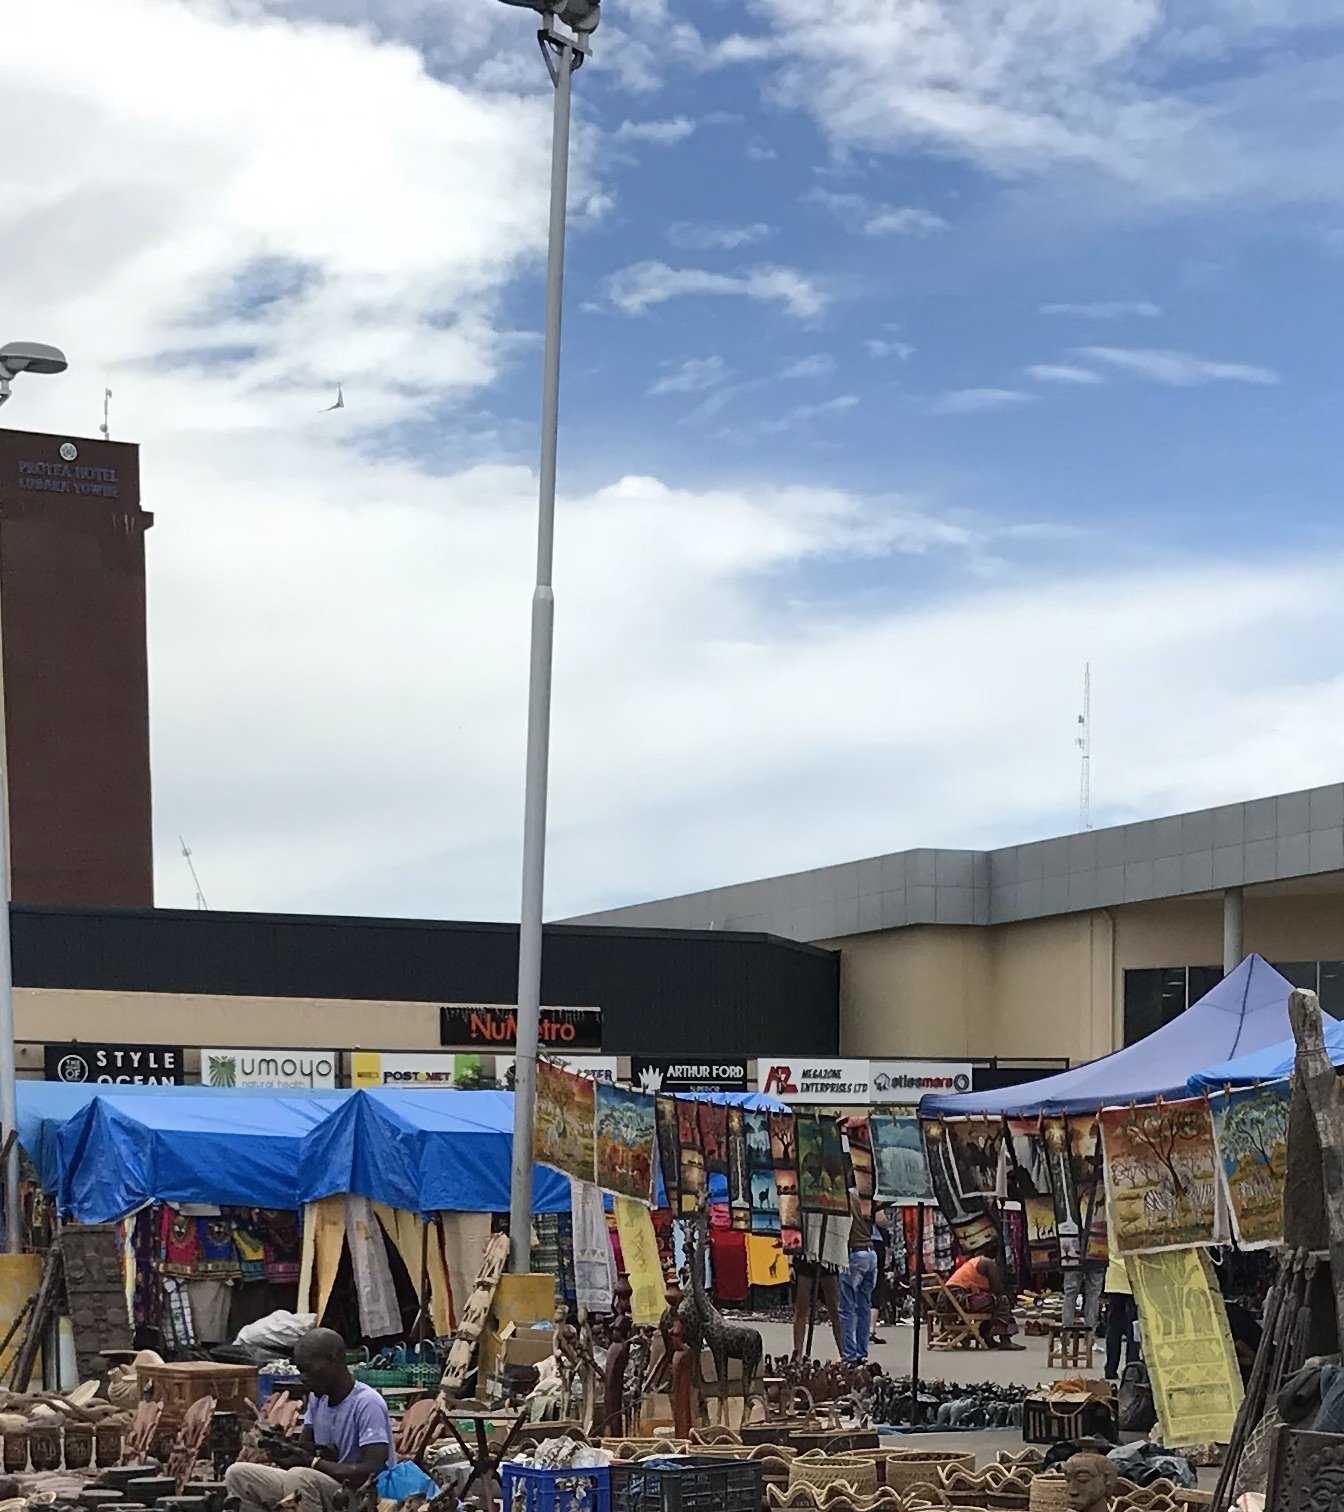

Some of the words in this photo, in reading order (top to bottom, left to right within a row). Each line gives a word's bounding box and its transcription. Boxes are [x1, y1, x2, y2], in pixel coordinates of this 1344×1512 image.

[75, 465, 118, 482] HOTEL
[96, 1050, 175, 1069] STYLE
[241, 1057, 333, 1089] umoyo
[666, 1065, 711, 1078] ARTHUR
[712, 1065, 744, 1078] FORD
[800, 1082, 852, 1093] ENTERPRISES
